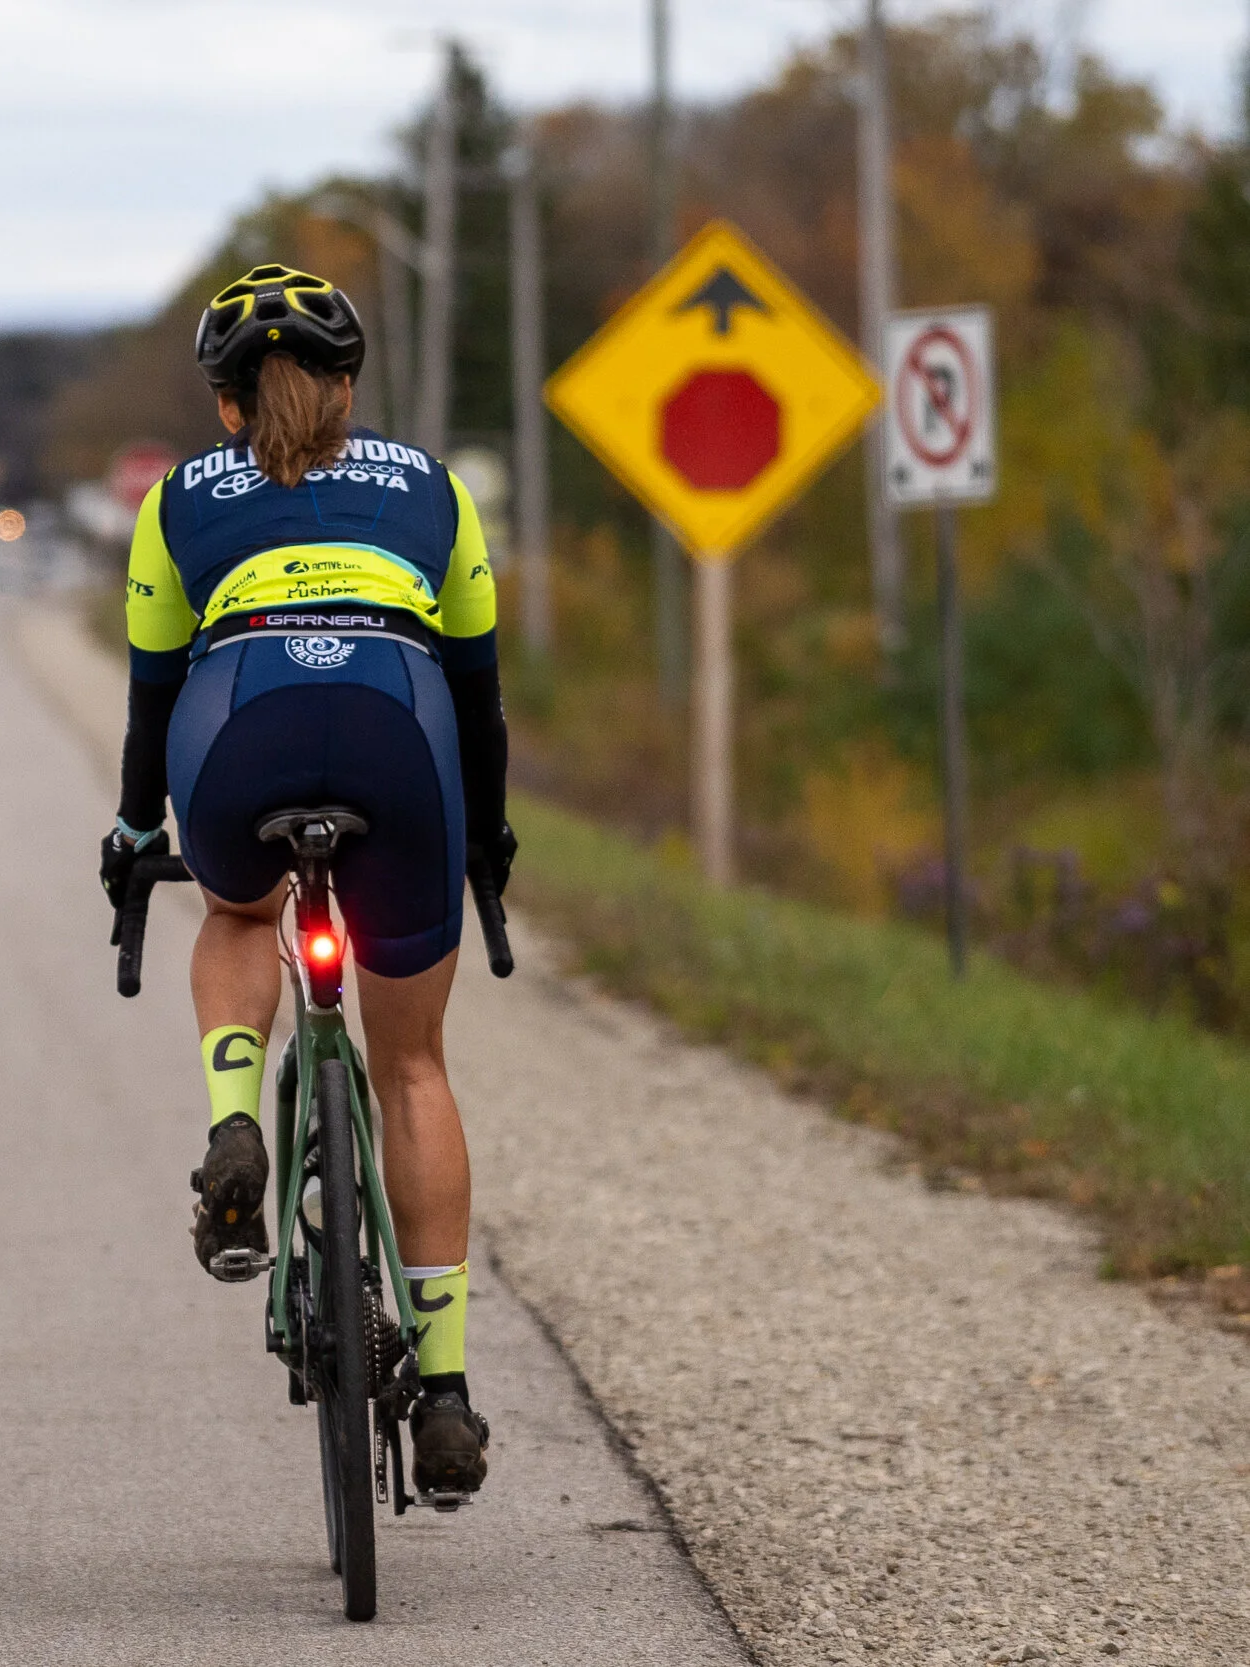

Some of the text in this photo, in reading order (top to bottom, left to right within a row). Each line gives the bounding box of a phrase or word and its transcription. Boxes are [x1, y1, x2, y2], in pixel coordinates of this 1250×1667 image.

[302, 469, 410, 492] OYOTA
[266, 614, 385, 627] GARNEAU
[291, 638, 356, 665] CREEMORE
